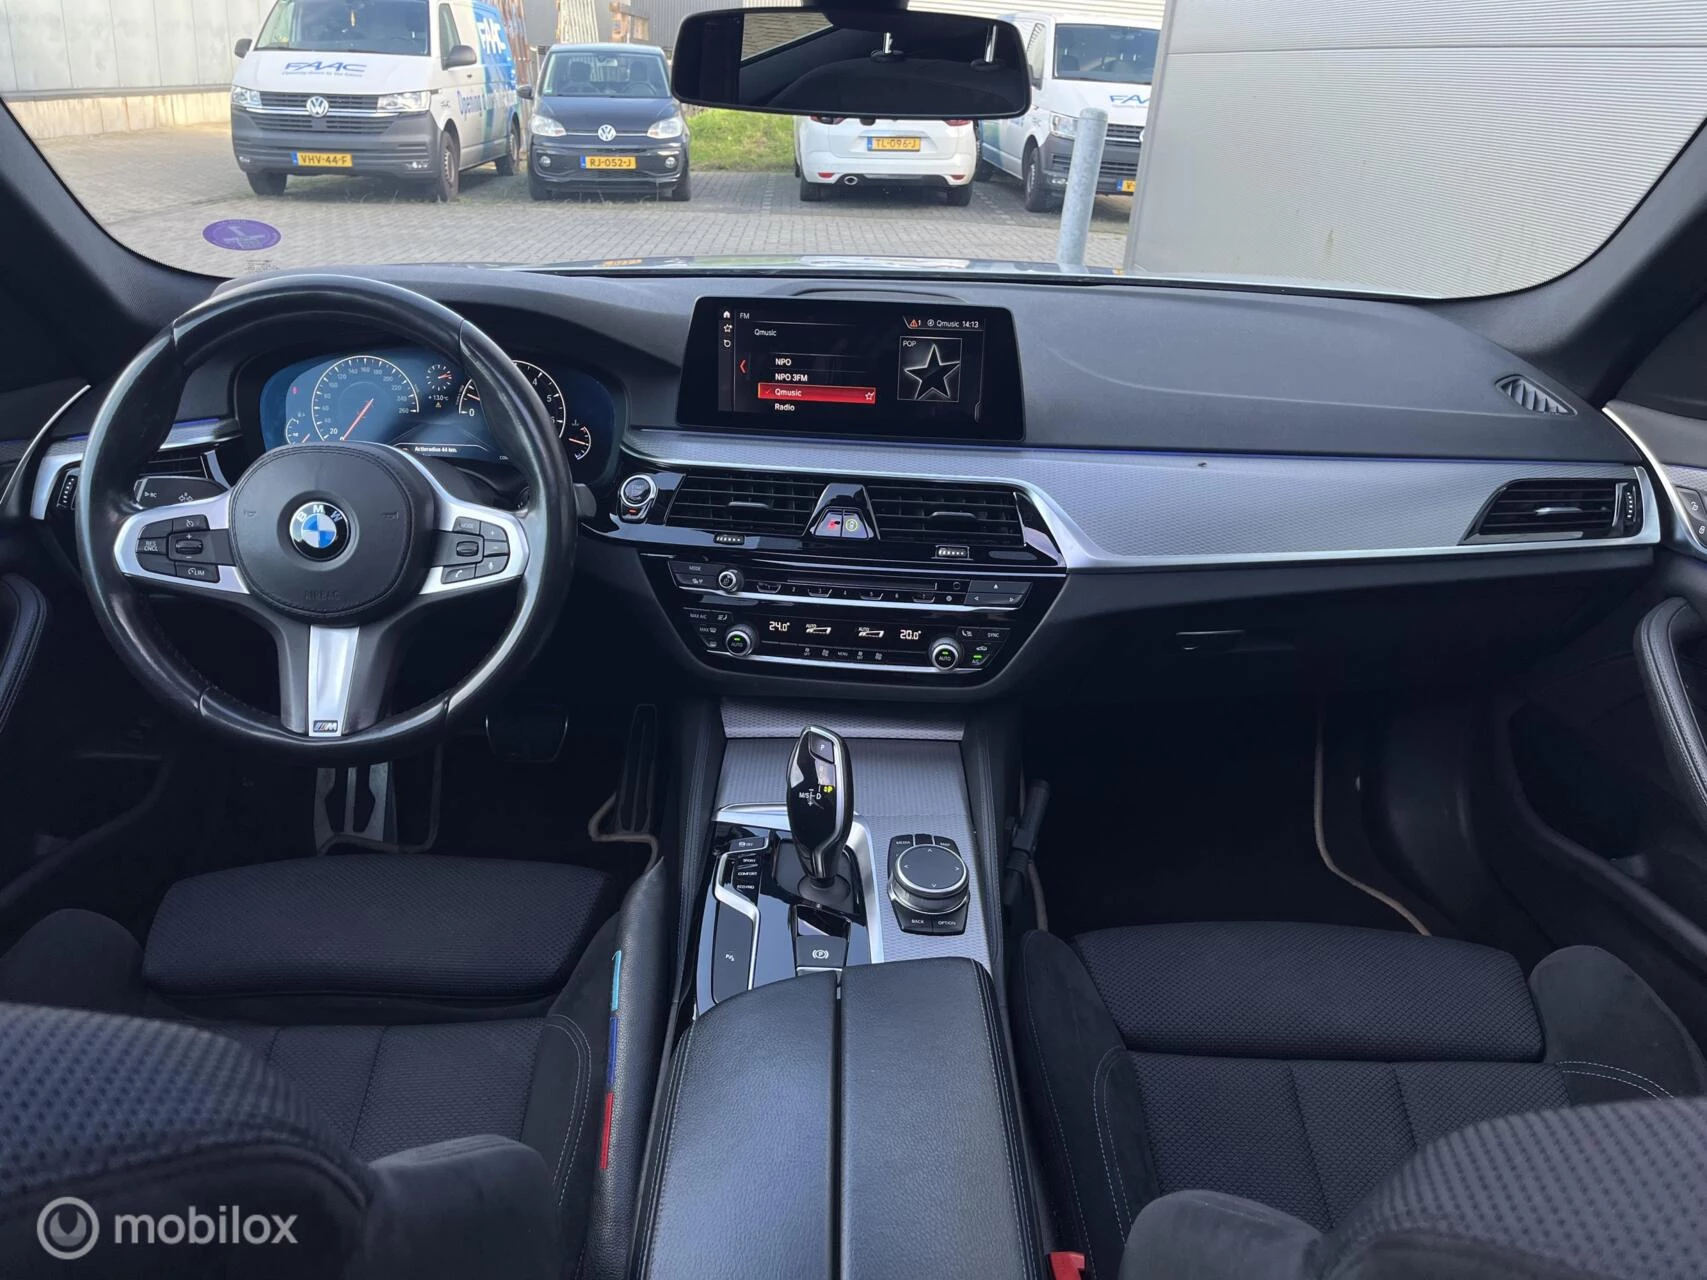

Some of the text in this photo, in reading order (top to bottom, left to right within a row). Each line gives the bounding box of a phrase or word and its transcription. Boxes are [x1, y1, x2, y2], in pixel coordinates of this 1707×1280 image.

[284, 61, 367, 73] FAAC
[875, 139, 916, 148] TL-096-J
[300, 155, 348, 165] VHV-44-F
[589, 158, 632, 167] RJ-052-J
[936, 319, 979, 328] Qmusic 14:13
[754, 328, 777, 337] Qmusic
[775, 358, 792, 366] NPO
[532, 378, 538, 386] 4
[775, 373, 808, 382] NPO 3FM
[774, 388, 802, 397] Qmusic
[546, 394, 552, 403] 5
[774, 403, 795, 411] Radio
[469, 408, 475, 417] 0
[329, 427, 338, 435] 20
[296, 504, 342, 522] BMW
